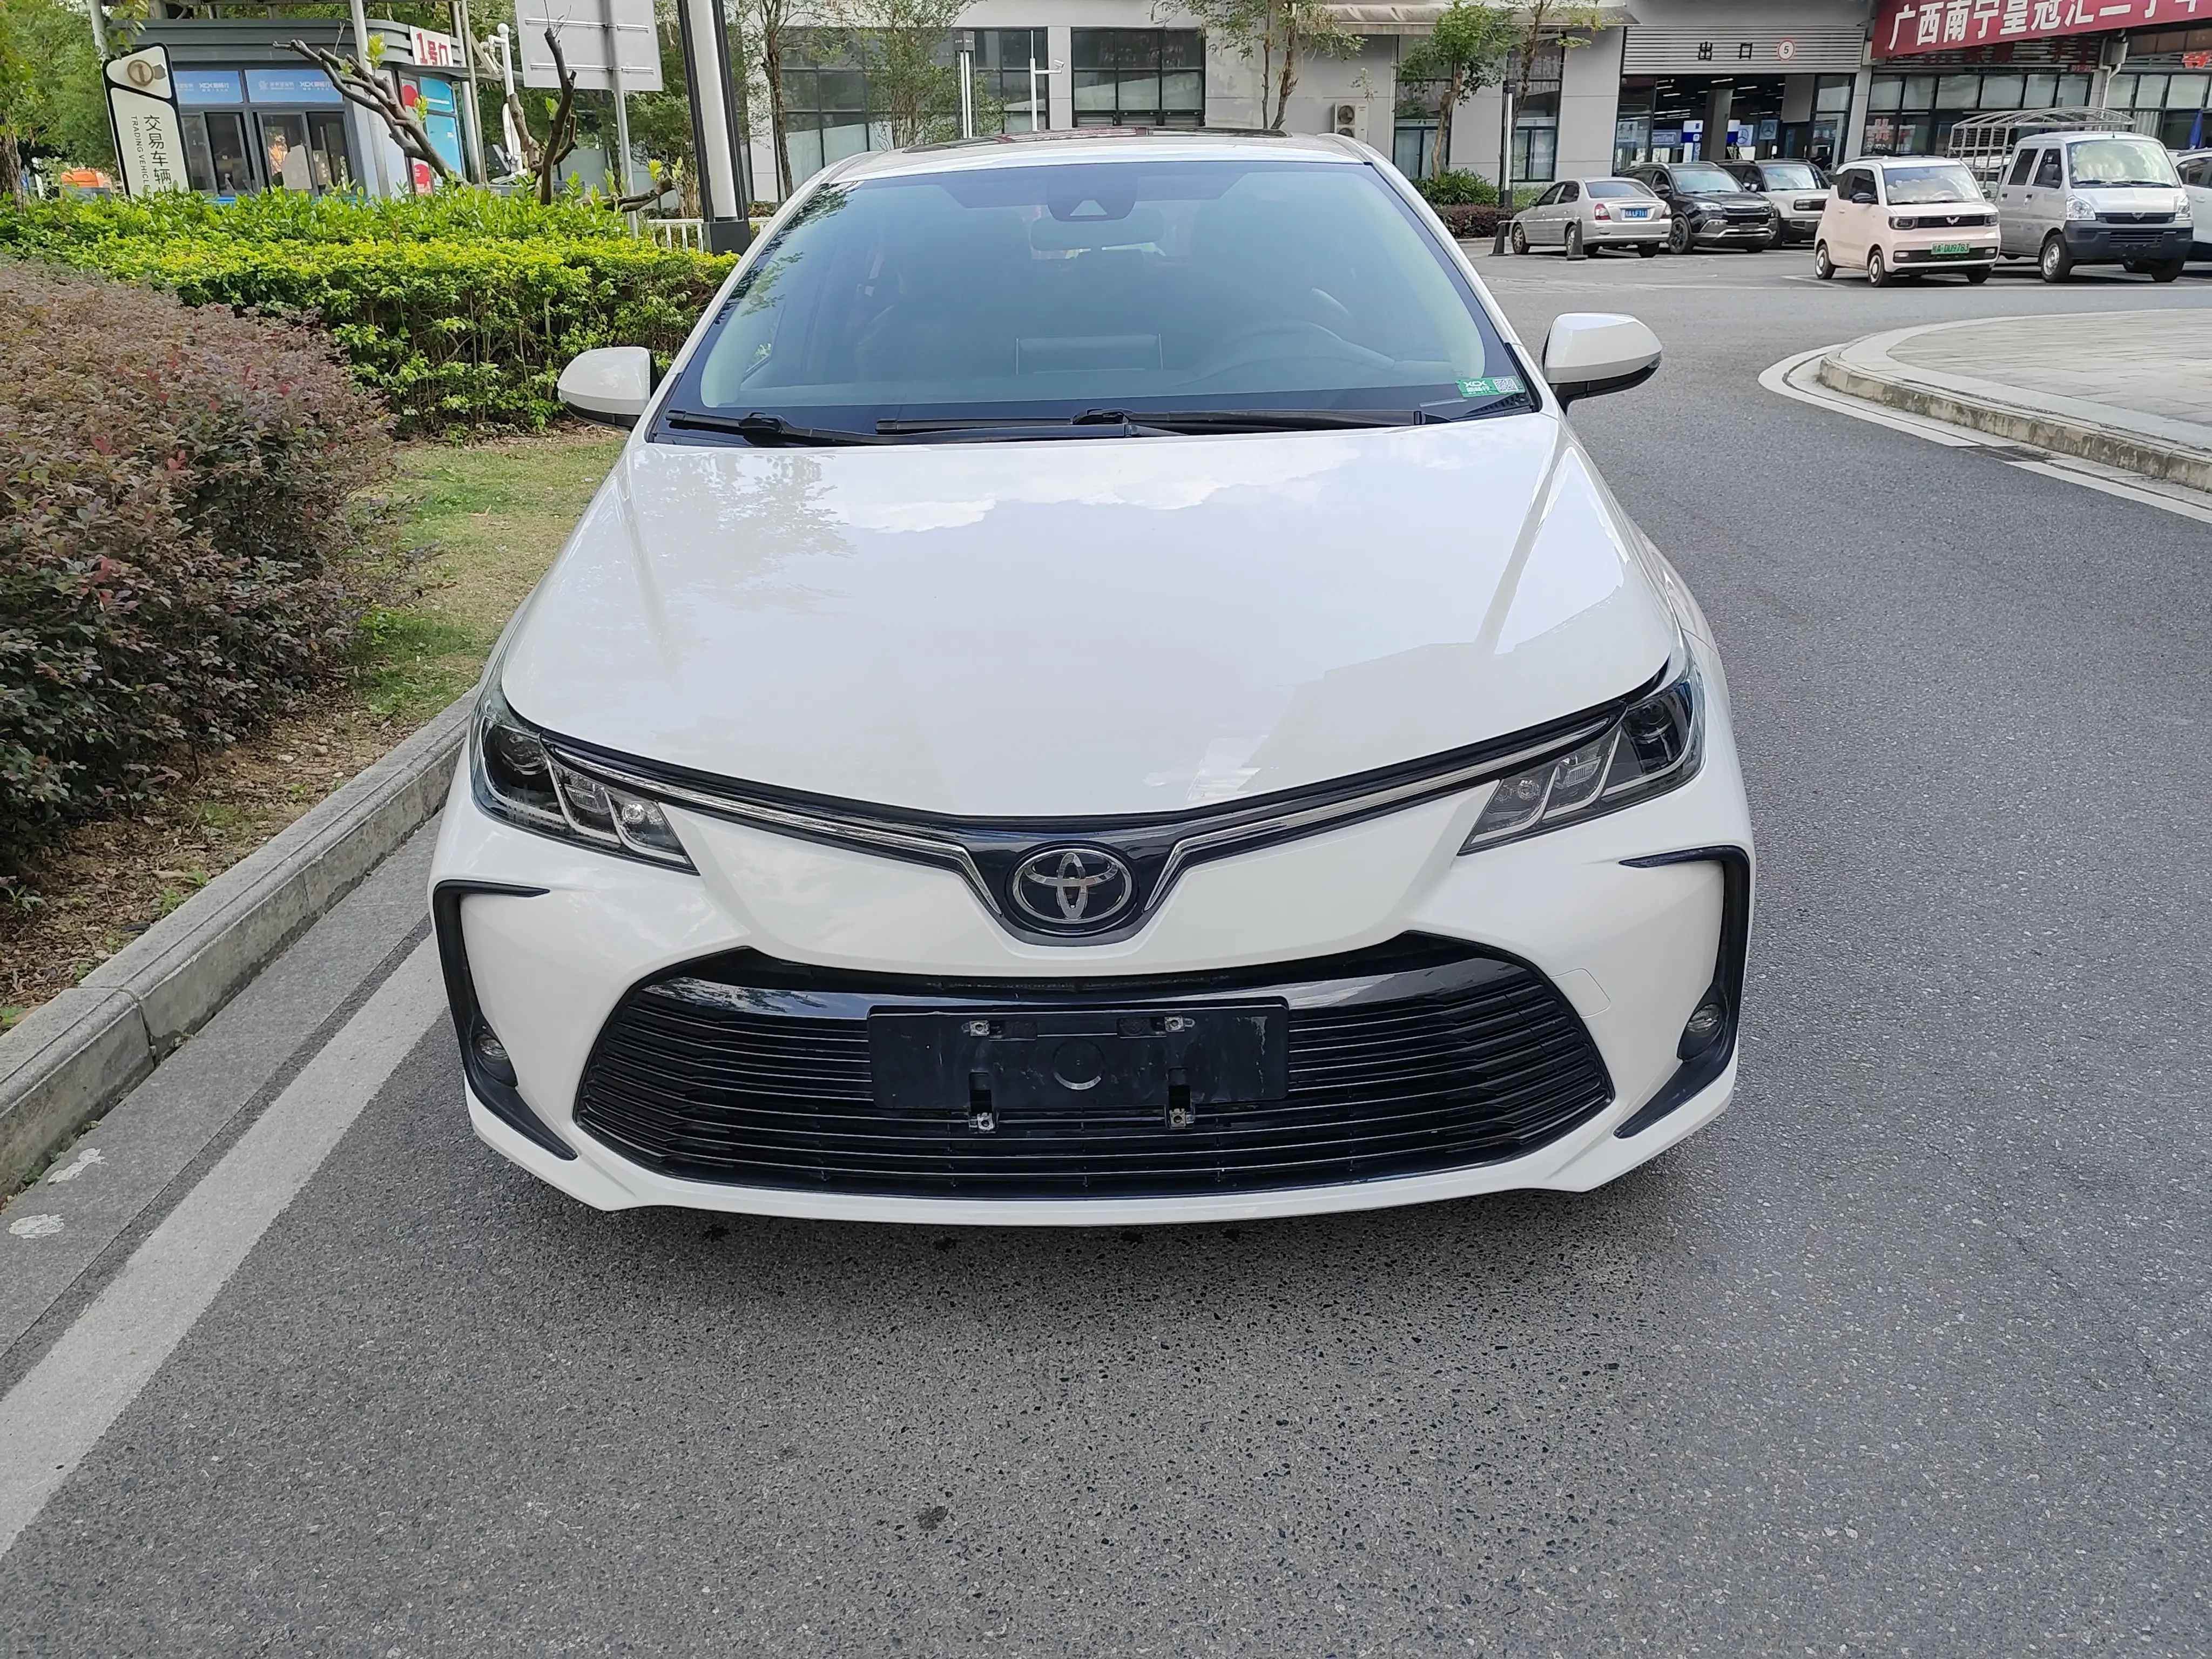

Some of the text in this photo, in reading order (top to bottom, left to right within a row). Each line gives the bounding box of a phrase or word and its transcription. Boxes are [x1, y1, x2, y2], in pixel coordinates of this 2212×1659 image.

[1888, 0, 2197, 50] 广西南宁皇冠汇
[416, 32, 449, 65] 1号门
[1698, 42, 1753, 61] 出口
[1783, 45, 1789, 54] 5
[131, 115, 151, 191] TRADING VEHICLE
